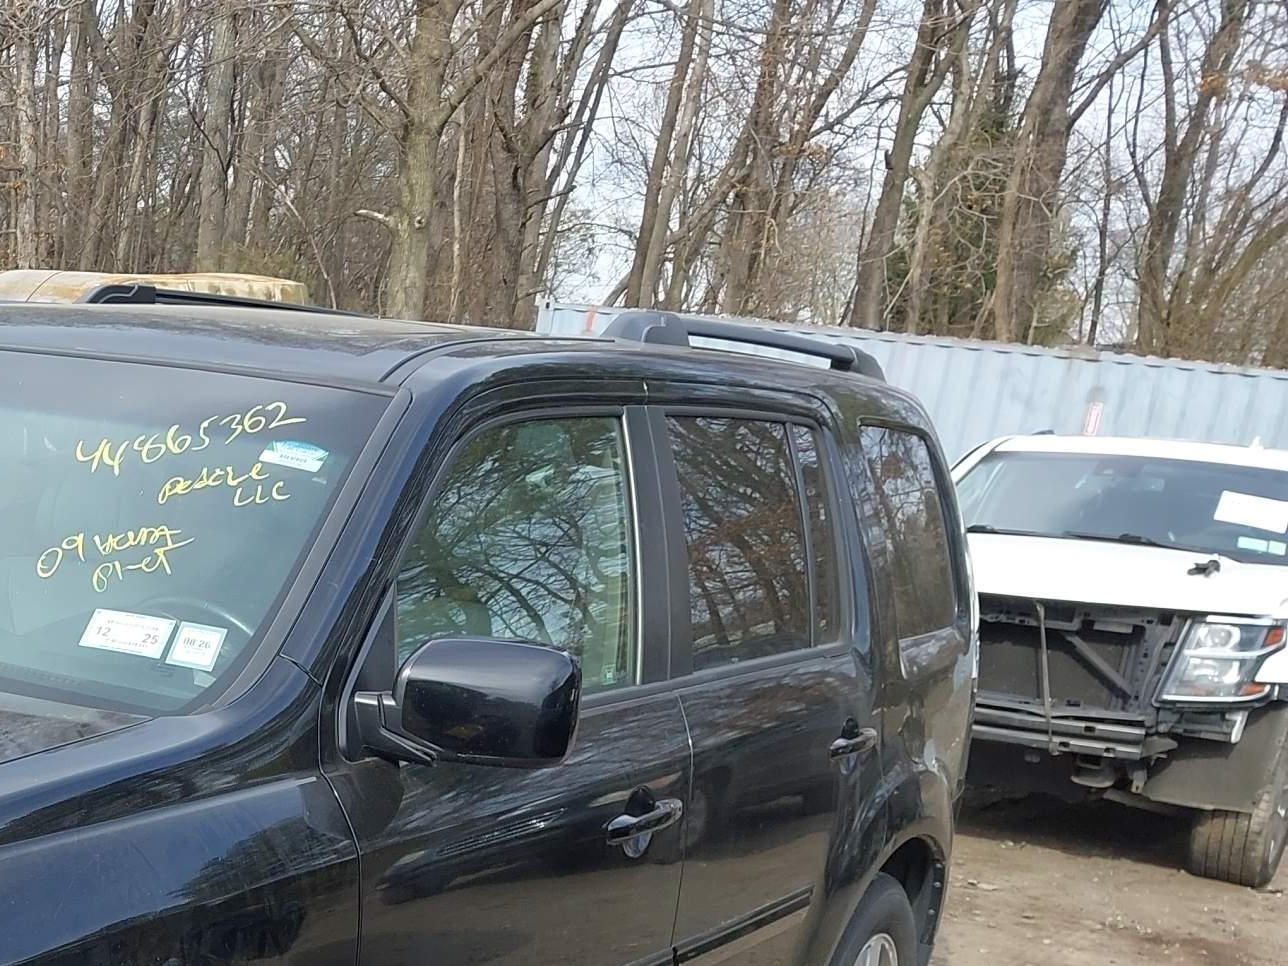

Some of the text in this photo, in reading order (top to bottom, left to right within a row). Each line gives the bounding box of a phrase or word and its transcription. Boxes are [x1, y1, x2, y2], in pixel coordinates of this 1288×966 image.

[75, 401, 307, 477] 44865362
[36, 532, 85, 579] 09
[96, 625, 111, 637] 12
[142, 633, 159, 645] 25
